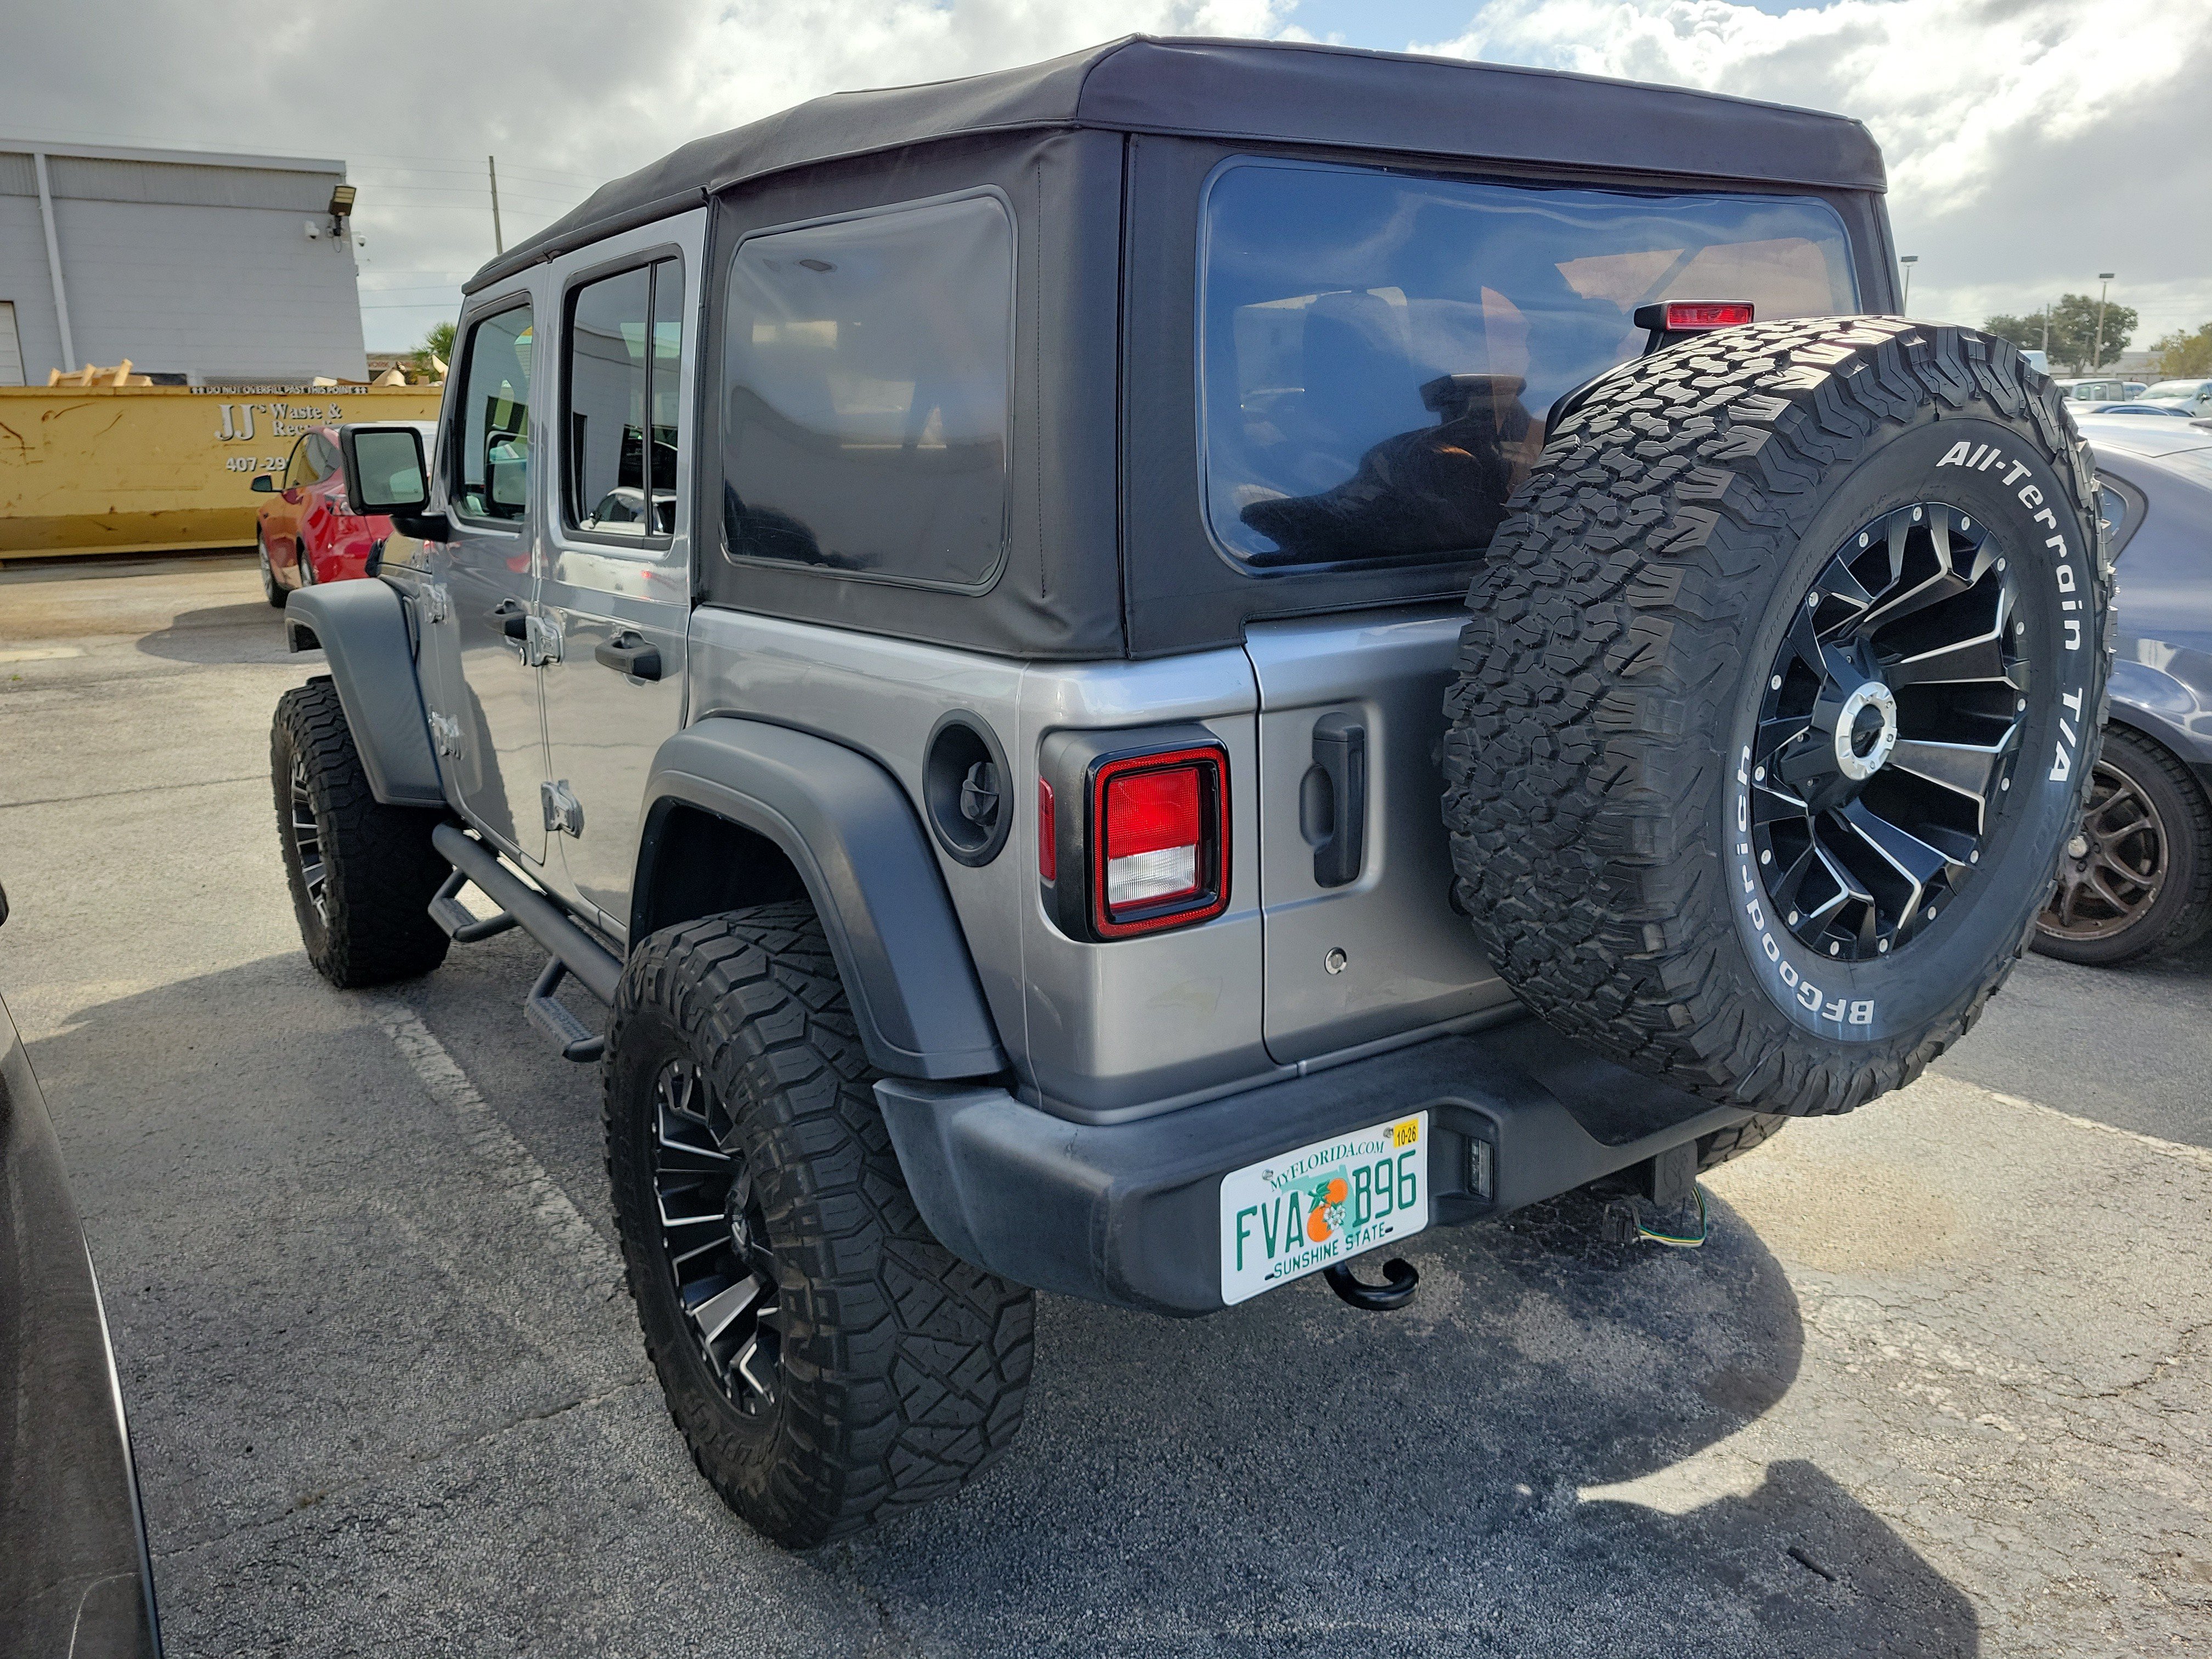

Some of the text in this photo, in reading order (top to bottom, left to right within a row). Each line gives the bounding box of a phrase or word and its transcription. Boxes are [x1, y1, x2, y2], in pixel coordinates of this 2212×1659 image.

[213, 404, 267, 441] JJ's
[269, 403, 323, 419] Waste
[329, 403, 343, 419] &
[226, 456, 289, 472] 407-29
[1936, 441, 2083, 651] All-Terrain
[2049, 687, 2083, 781] T/A
[1736, 745, 1875, 1025] BFGoodrich
[1397, 1125, 1417, 1147] 10-26
[1270, 1141, 1385, 1193] MYFLORIDA.COM
[1236, 1149, 1417, 1272] FVA B96
[1273, 1221, 1385, 1279] SUNSHINE STATE
